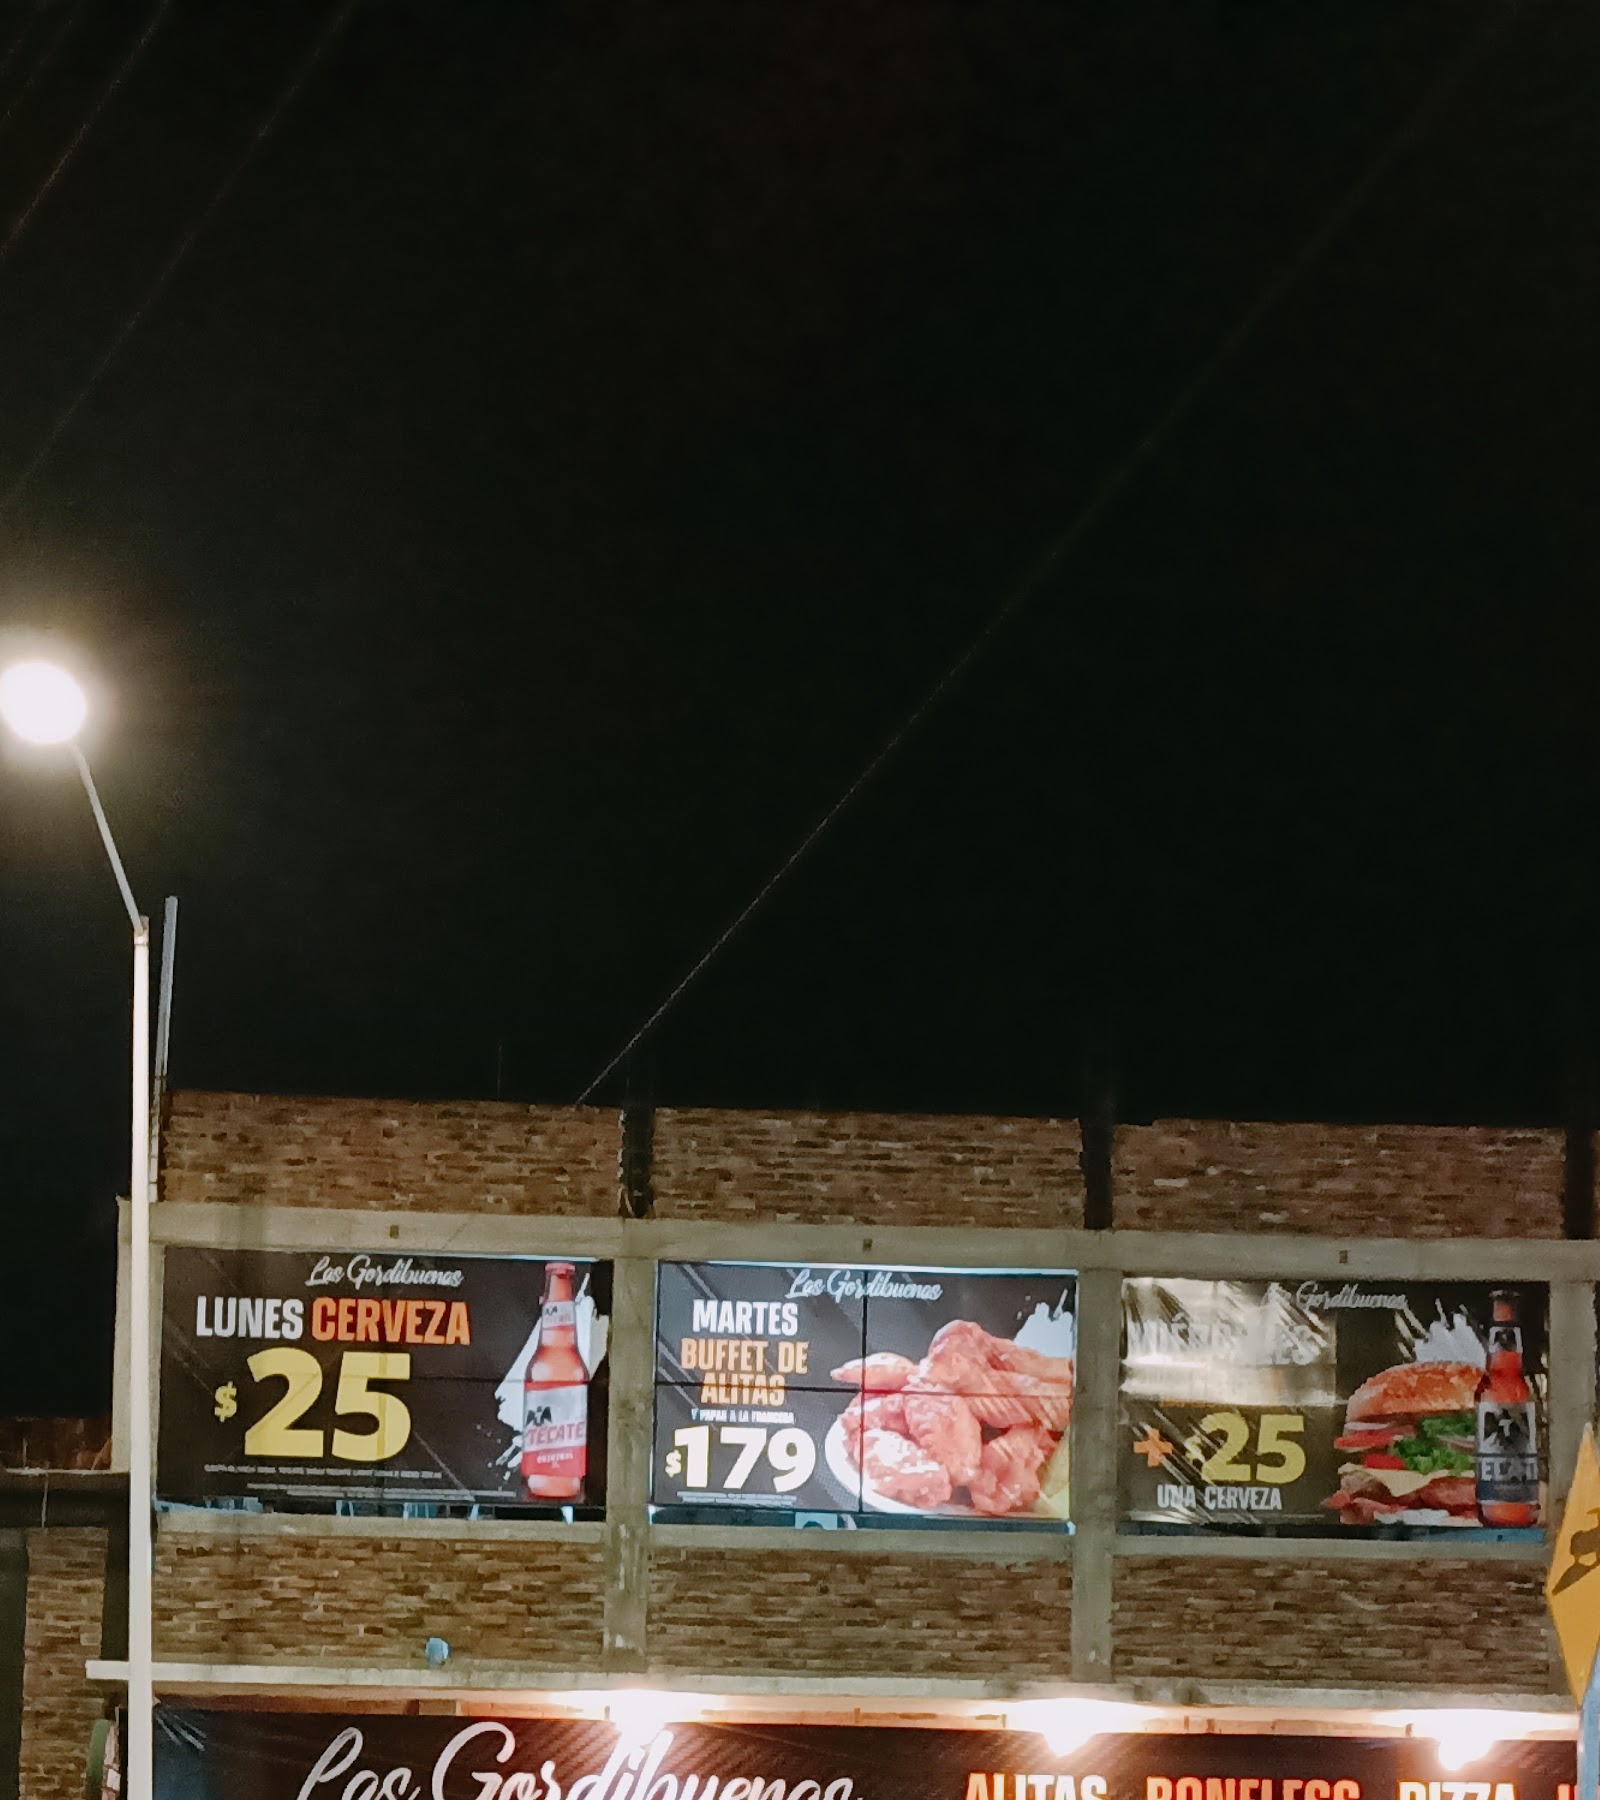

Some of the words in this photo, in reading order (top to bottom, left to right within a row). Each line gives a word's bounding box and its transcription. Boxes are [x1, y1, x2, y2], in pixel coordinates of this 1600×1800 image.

[305, 1255, 345, 1287] Las
[346, 1254, 463, 1290] Gordibuenas
[785, 1269, 825, 1299] Las
[826, 1270, 943, 1303] Gordibuenas
[196, 1295, 304, 1339] LUNES
[311, 1297, 471, 1345] CERVEZA
[692, 1299, 798, 1336] MARTES
[681, 1337, 769, 1371] BUFFET
[778, 1340, 809, 1375] DE
[700, 1372, 786, 1406] ALITAS
[527, 1421, 585, 1446] TECATE
[1157, 1484, 1197, 1510] UNA
[1204, 1485, 1283, 1510] CERVEZA
